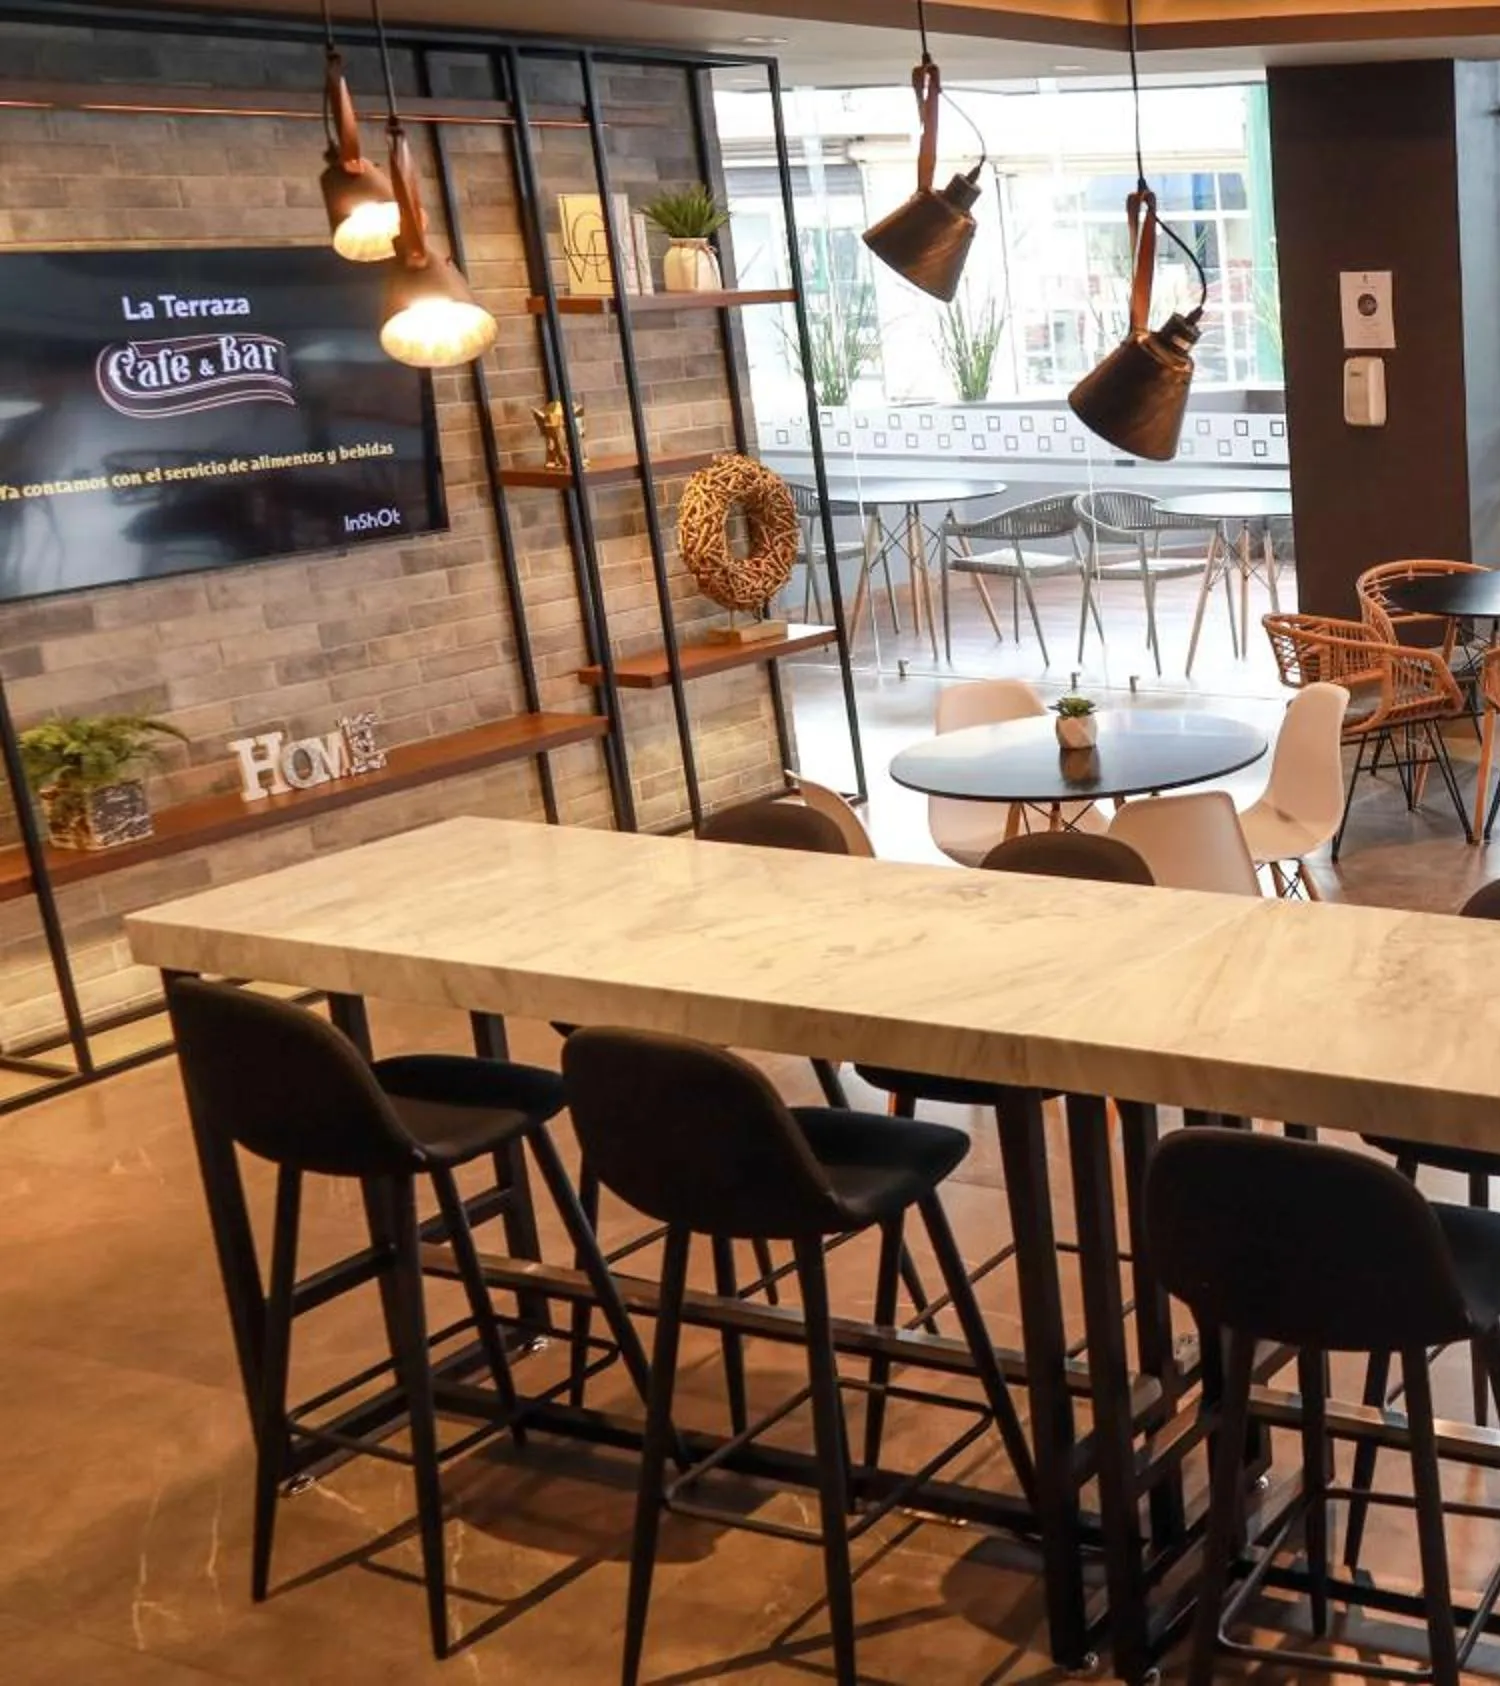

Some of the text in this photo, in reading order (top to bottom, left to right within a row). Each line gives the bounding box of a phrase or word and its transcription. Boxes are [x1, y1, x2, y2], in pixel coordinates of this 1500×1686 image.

[122, 294, 250, 320] La Terraza
[199, 358, 215, 376] &
[218, 335, 277, 373] Bar
[23, 476, 109, 497] contamos
[111, 472, 143, 488] con
[144, 466, 162, 483] el
[165, 460, 227, 479] servicio
[229, 457, 249, 473] de
[251, 451, 325, 471] alimentos
[327, 449, 338, 465] y
[338, 442, 395, 460] bebidas
